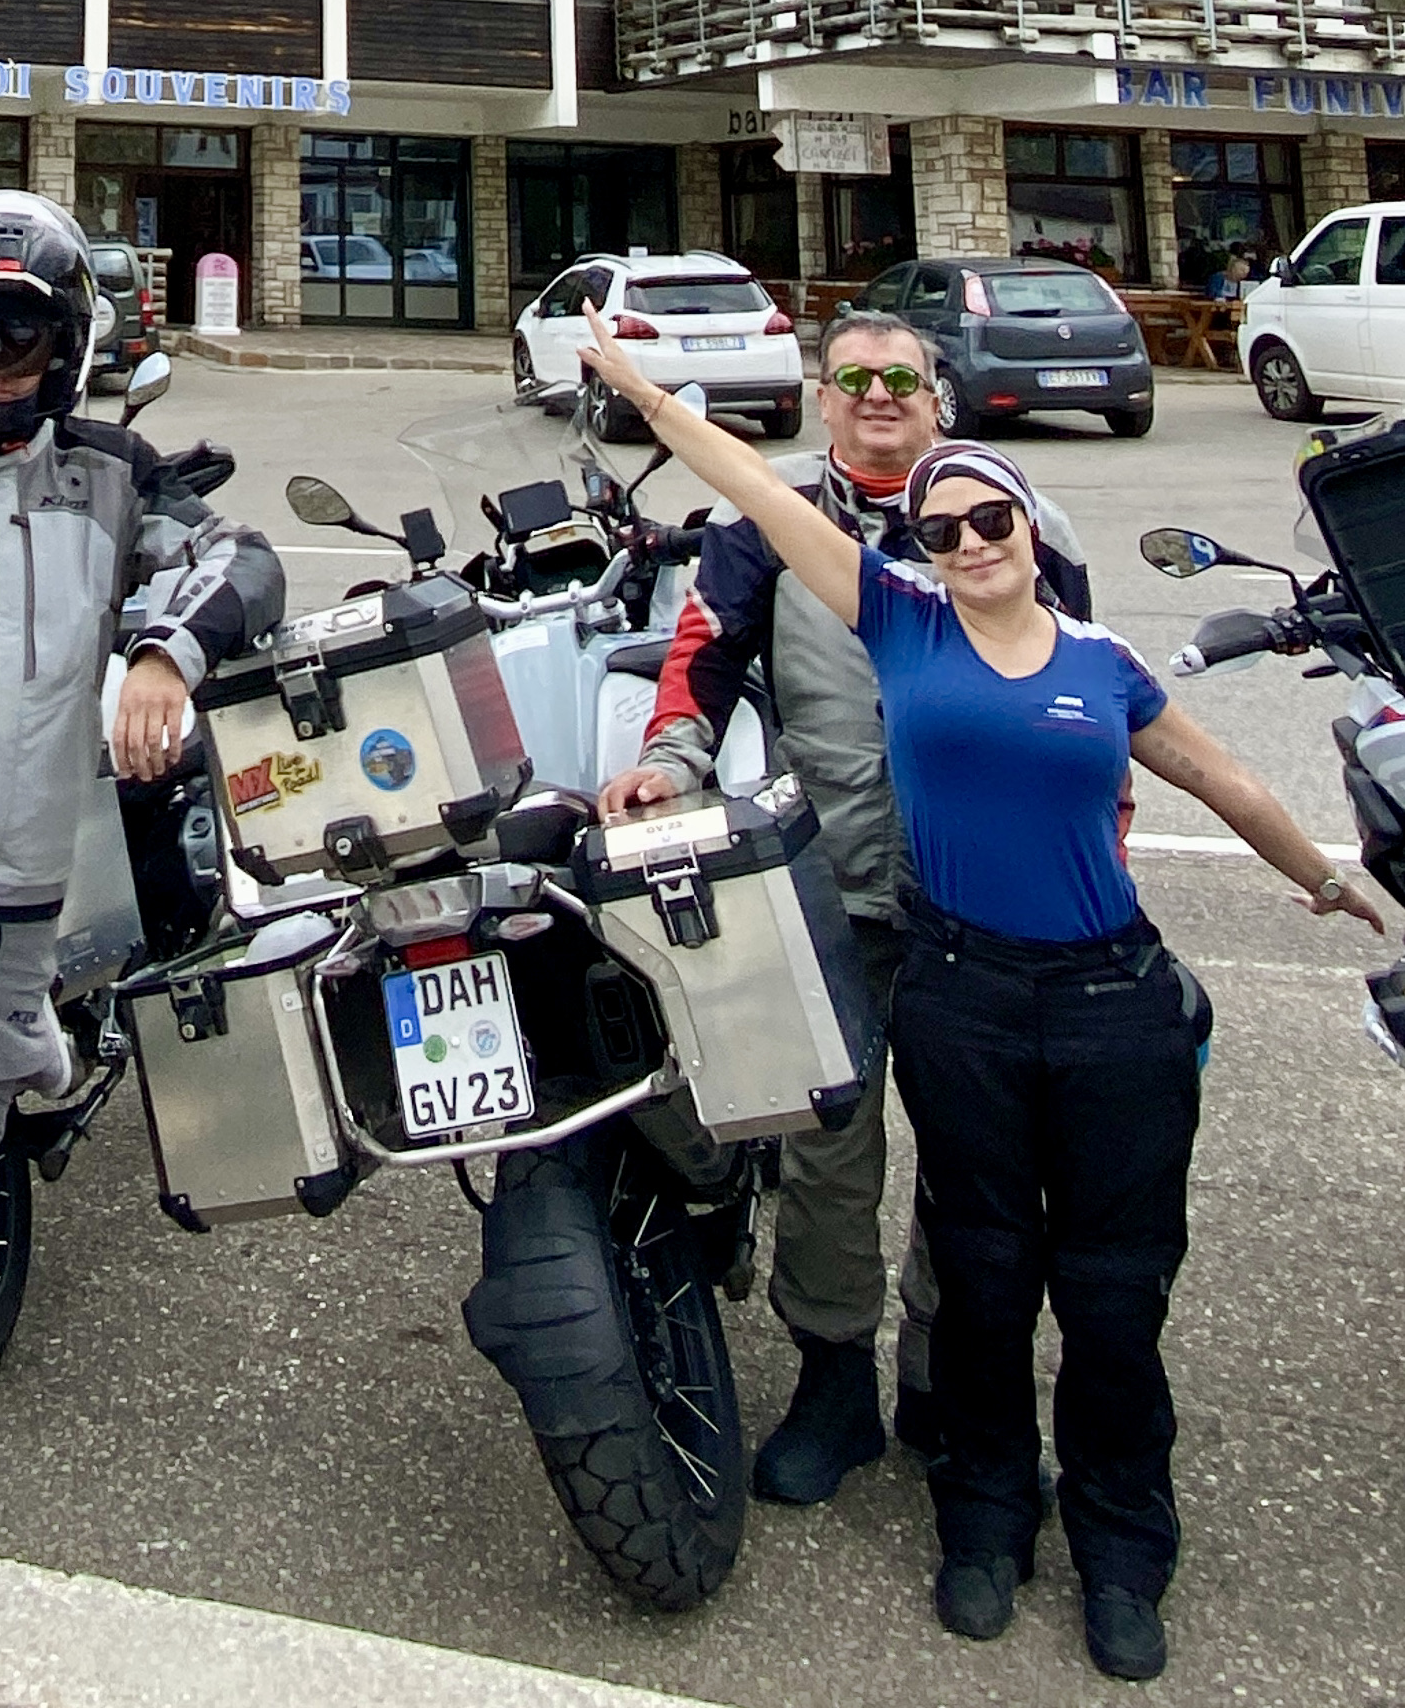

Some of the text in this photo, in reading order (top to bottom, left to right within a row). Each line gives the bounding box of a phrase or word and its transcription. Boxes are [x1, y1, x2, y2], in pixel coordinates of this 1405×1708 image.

[63, 65, 353, 117] SOUVENIRS
[1117, 66, 1210, 109] BAR
[727, 108, 772, 135] bar
[226, 756, 280, 806] MX
[417, 960, 499, 1017] DAH
[399, 1018, 413, 1039] D
[408, 1065, 520, 1127] GV 23
